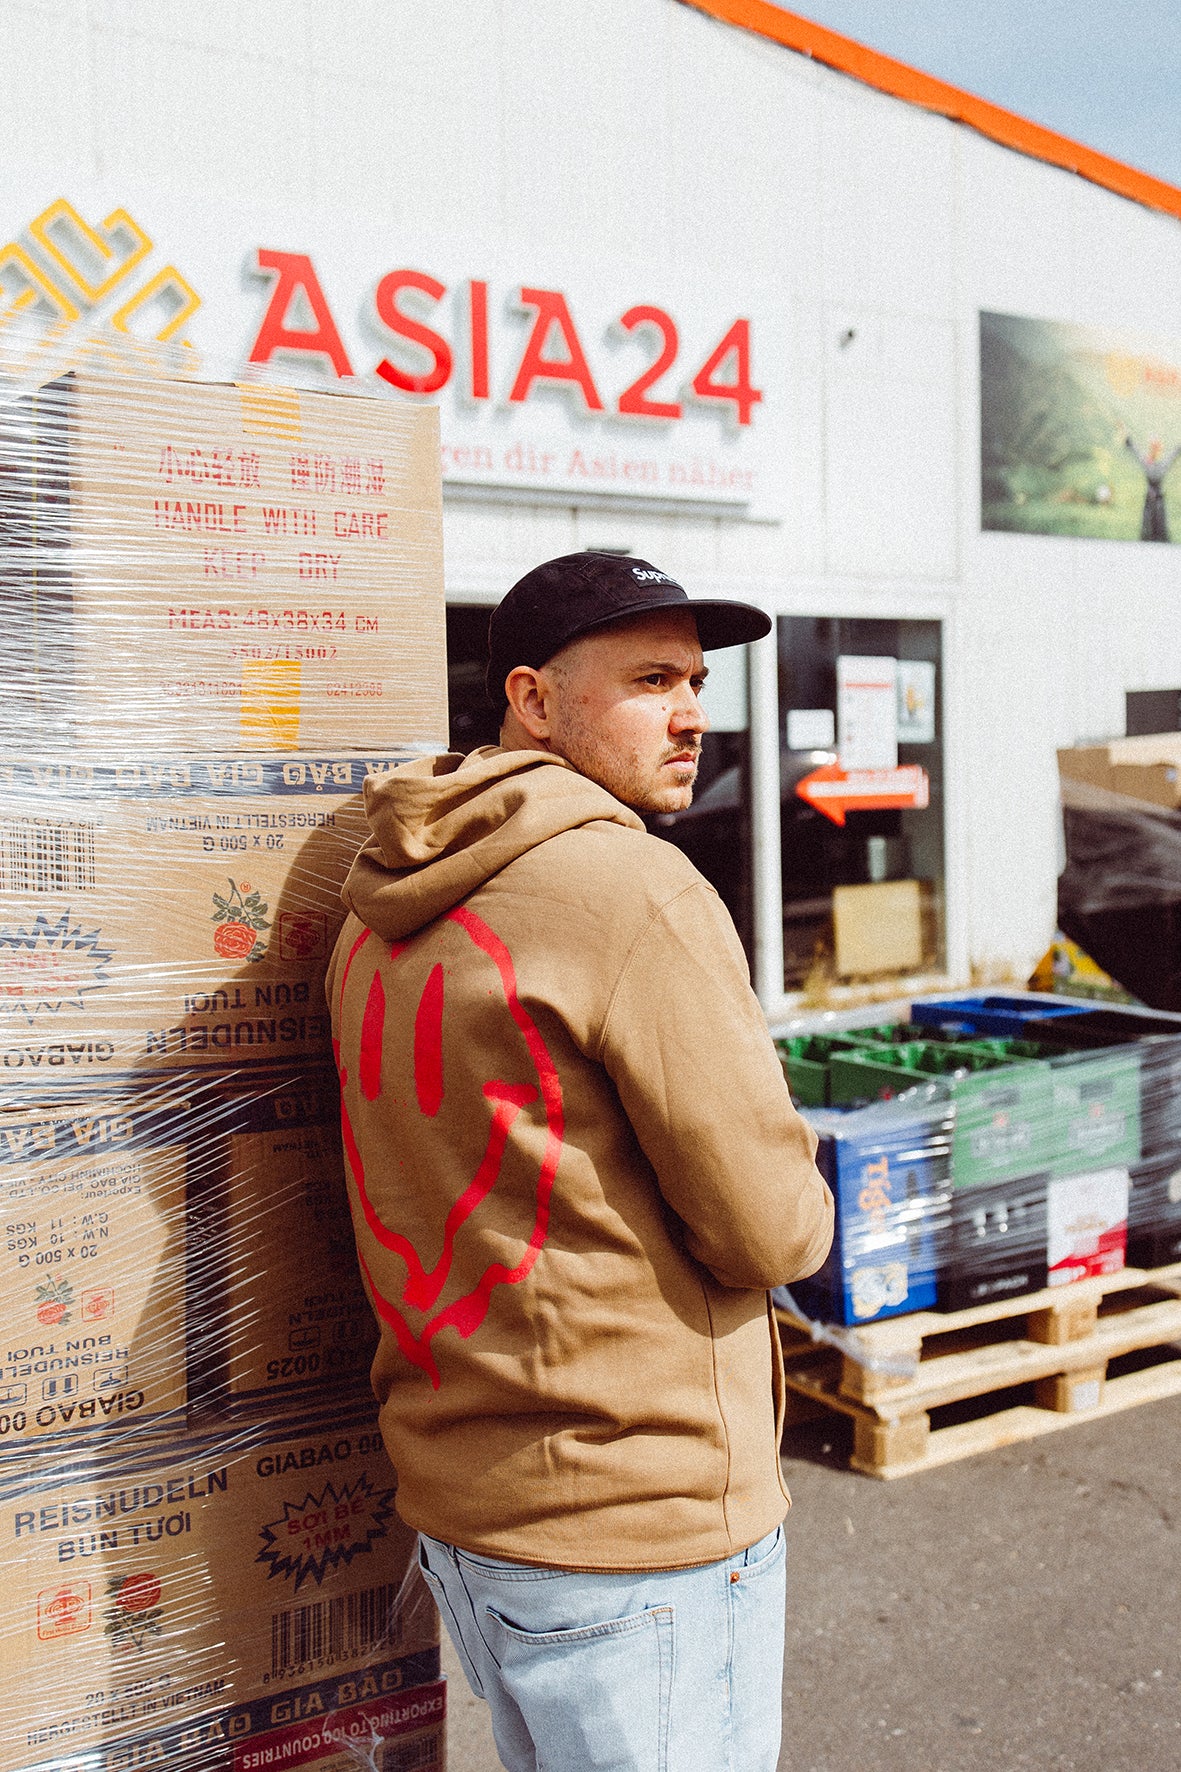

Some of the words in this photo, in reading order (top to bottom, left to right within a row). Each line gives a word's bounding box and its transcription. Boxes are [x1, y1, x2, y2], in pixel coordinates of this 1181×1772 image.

[248, 247, 763, 427] ASIA24
[567, 448, 659, 484] Asien
[154, 500, 247, 533] HANDLE
[262, 506, 317, 537] WITH
[333, 511, 390, 541] CARE
[202, 836, 216, 852] G
[220, 834, 249, 851] 500
[266, 834, 285, 850] 20
[5, 1221, 37, 1237] KGS
[7, 1236, 39, 1251] KGS
[80, 1244, 99, 1259] 20
[18, 1254, 31, 1268] G
[36, 1249, 62, 1265] 500
[65, 1334, 112, 1353] BÚN
[266, 1353, 320, 1380] 0025
[34, 1389, 145, 1428] GIABAO
[256, 1437, 352, 1478] GIABAO
[14, 1466, 229, 1538] REISNUDELN
[270, 1693, 325, 1725] GIA
[242, 1733, 321, 1770] COUNTRIES
